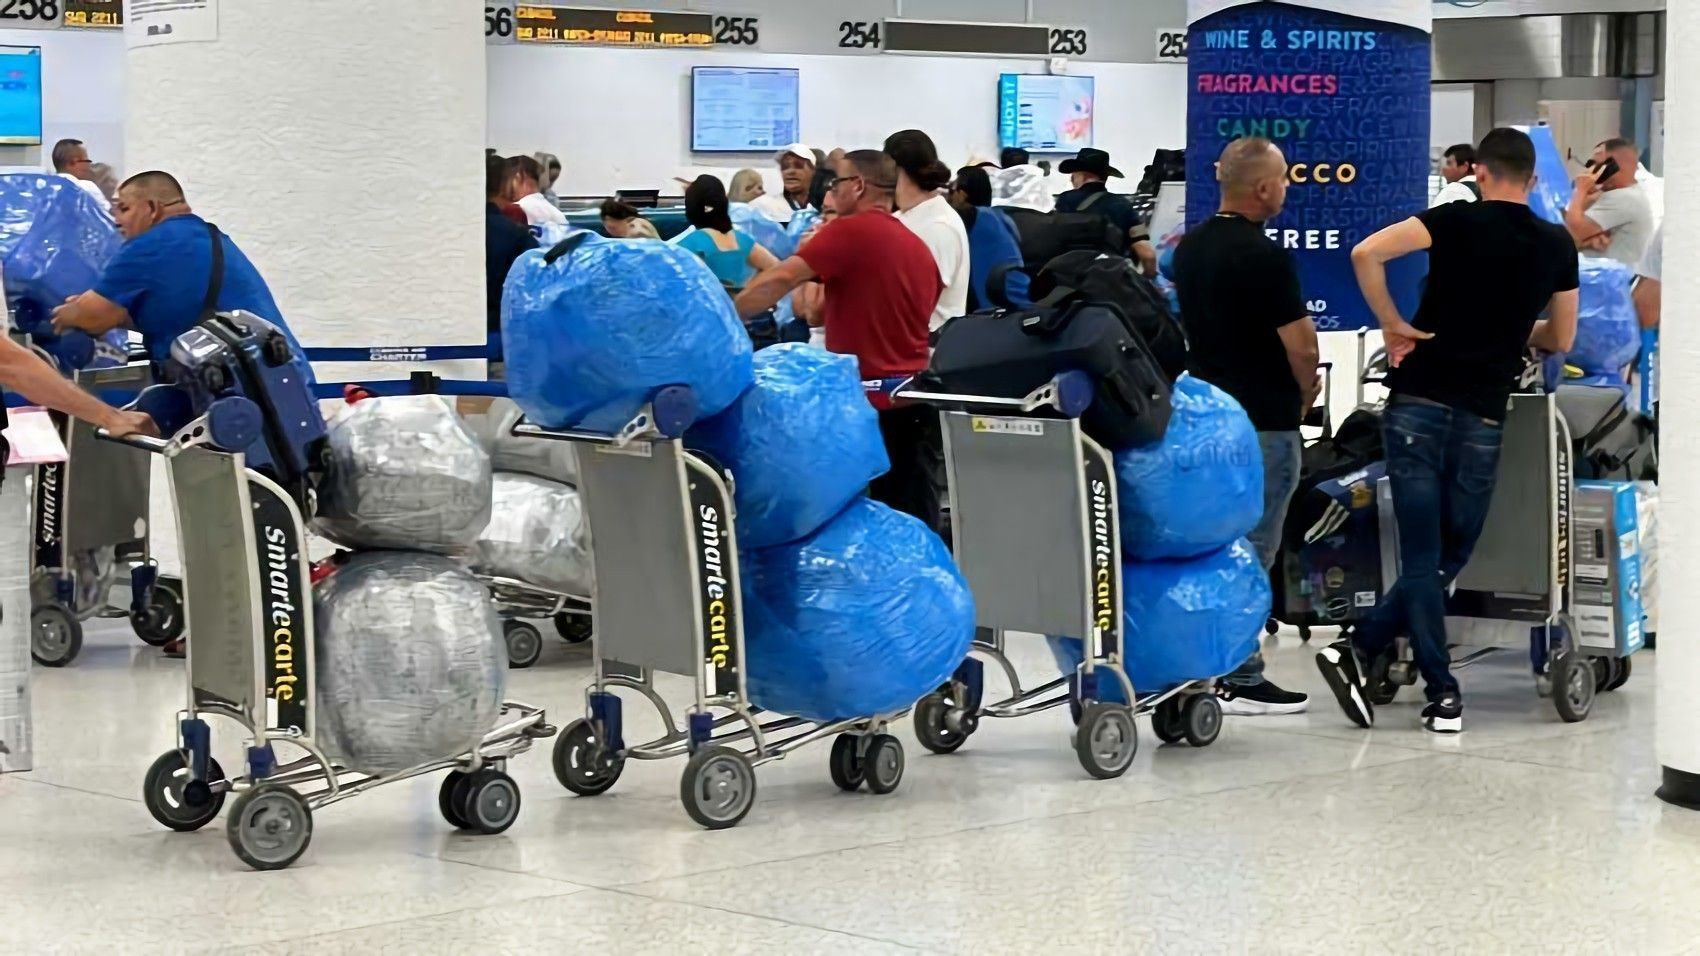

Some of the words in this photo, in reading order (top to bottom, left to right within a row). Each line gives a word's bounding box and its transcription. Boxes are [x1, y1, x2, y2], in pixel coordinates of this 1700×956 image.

[0, 0, 58, 20] 258
[485, 7, 512, 37] 56
[715, 16, 759, 45] 255
[838, 21, 881, 49] 254
[1050, 29, 1087, 55] 253
[1205, 30, 1249, 49] WINE
[1260, 30, 1277, 49] &
[1287, 30, 1376, 50] SPIRITS
[1197, 74, 1338, 95] FRAGRANCES
[1217, 118, 1311, 138] CANDY
[1091, 479, 1112, 632] smartecarte
[699, 504, 730, 668] smartecarte
[265, 525, 298, 701] smartecarte
